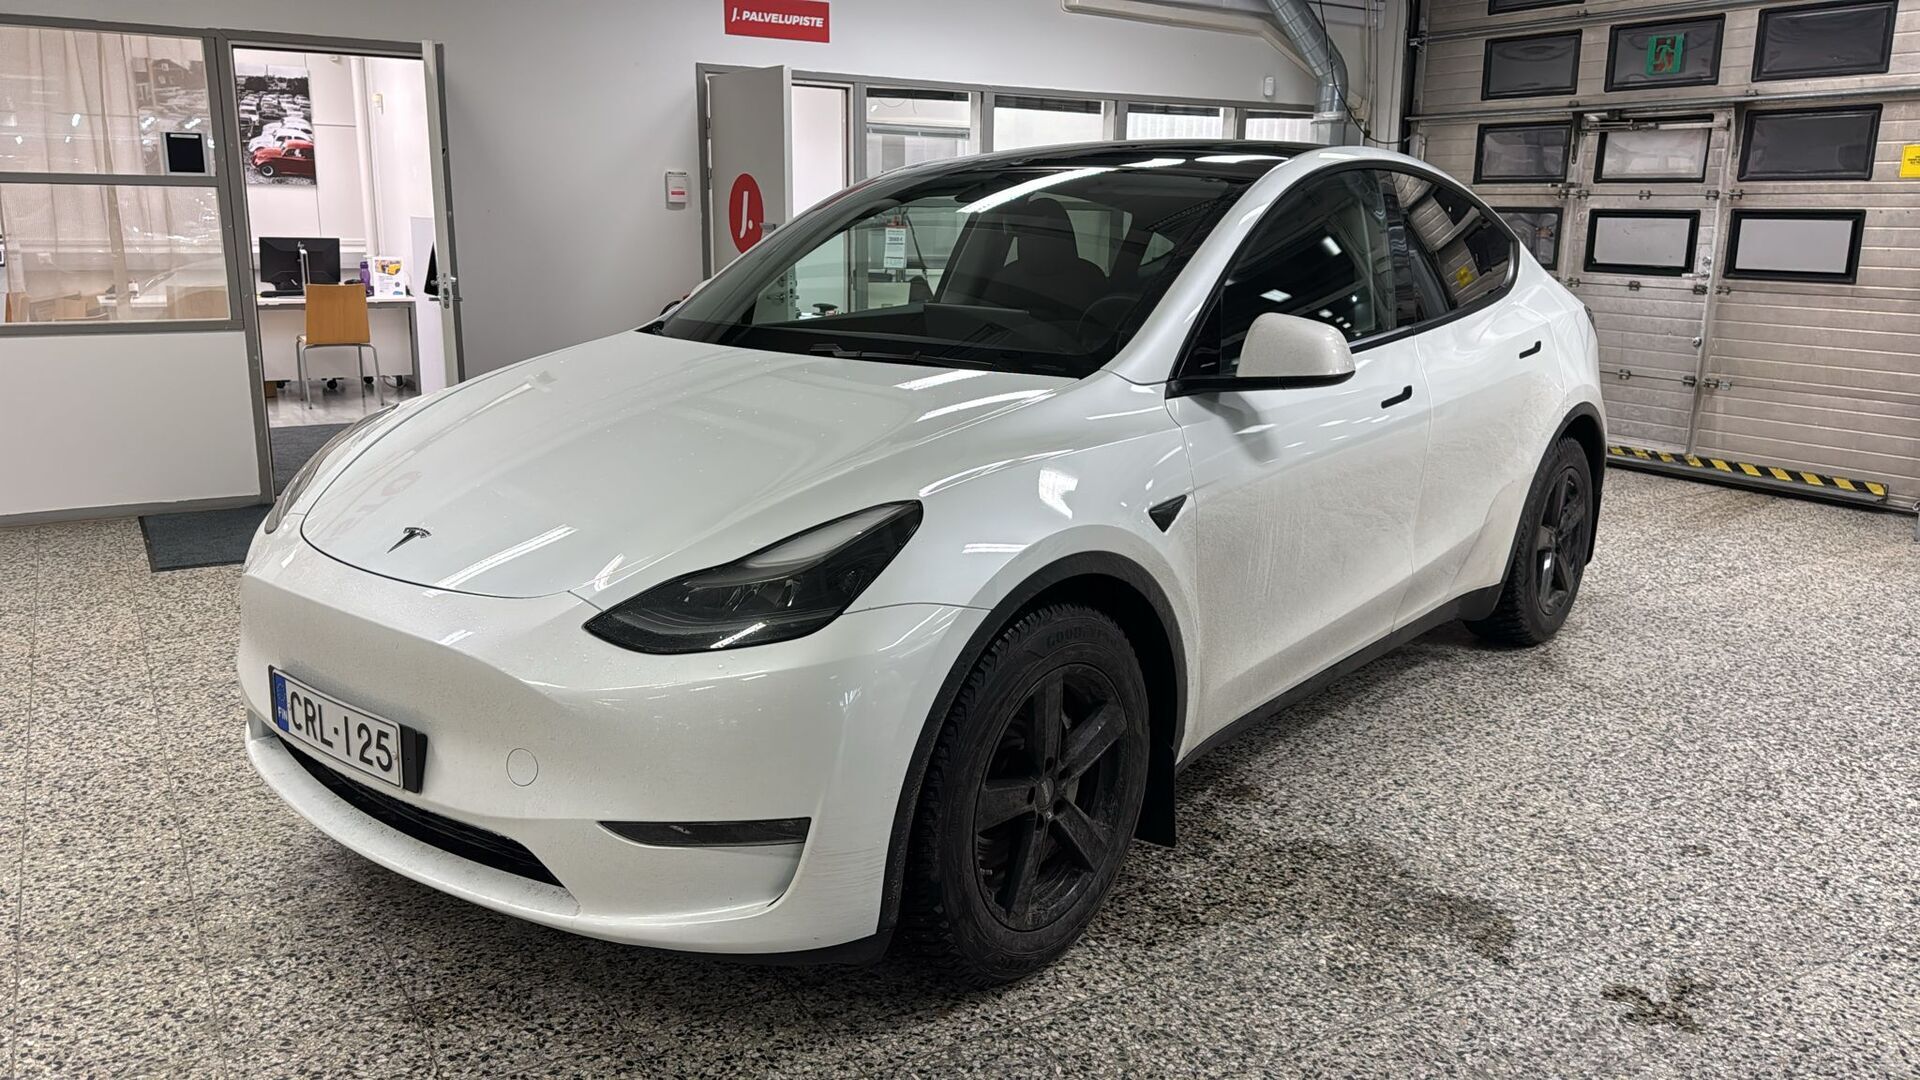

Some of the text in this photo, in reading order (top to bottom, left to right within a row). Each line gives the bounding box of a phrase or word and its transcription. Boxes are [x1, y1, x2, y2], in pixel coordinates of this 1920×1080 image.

[731, 7, 824, 28] J. PALVELUPISTE
[740, 191, 754, 239] J.
[277, 705, 288, 721] FIN
[290, 691, 393, 772] CRL-125
